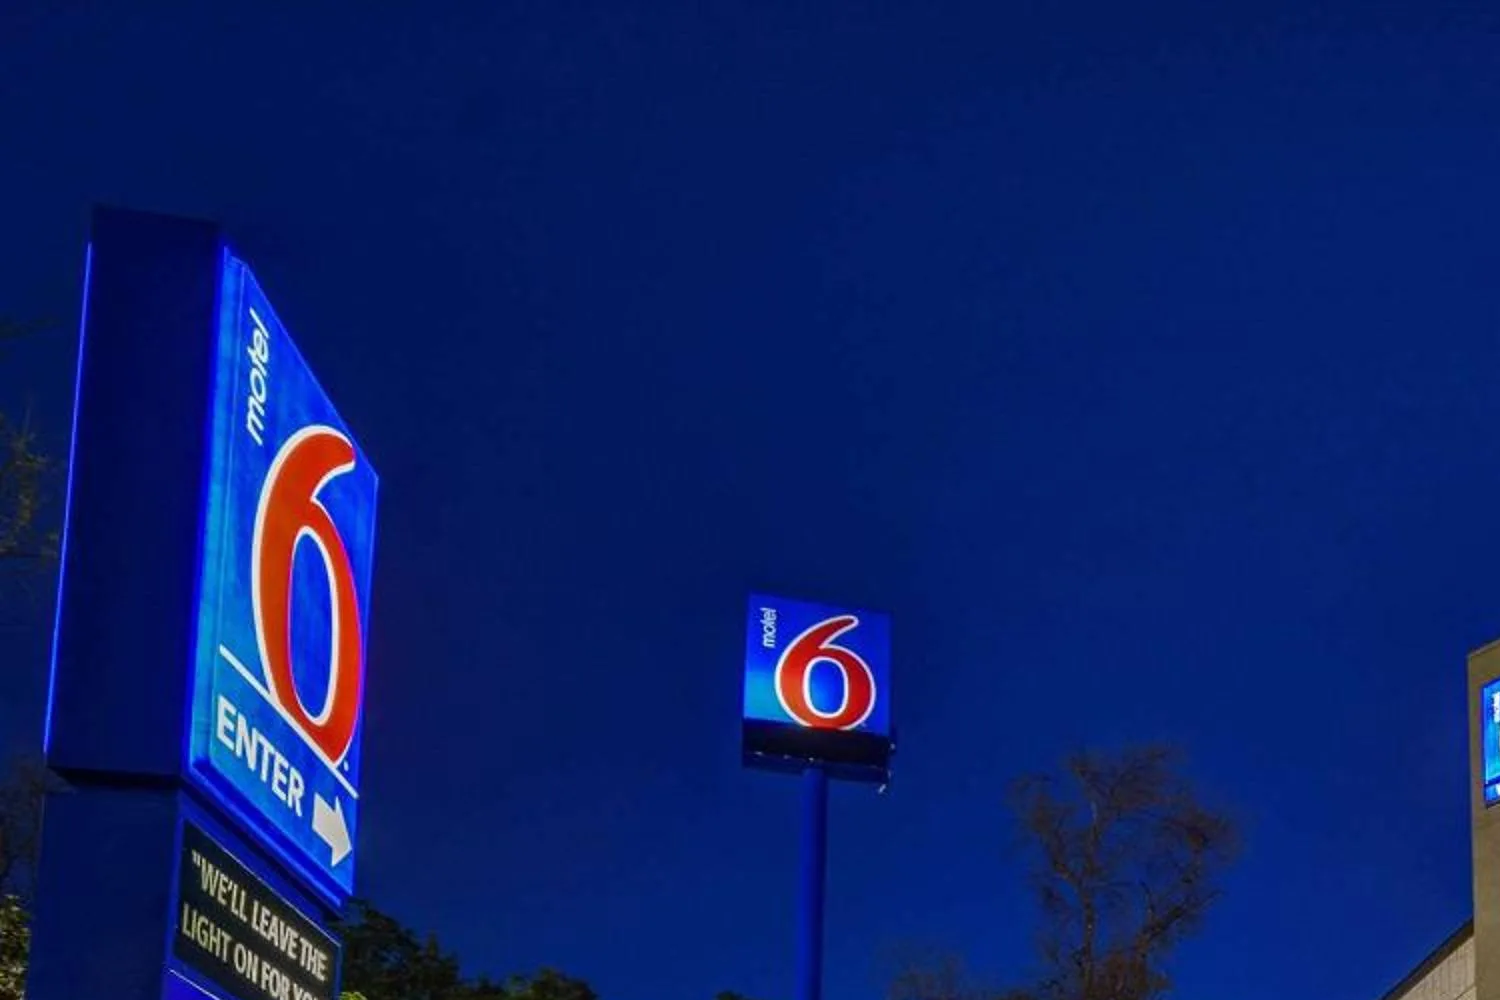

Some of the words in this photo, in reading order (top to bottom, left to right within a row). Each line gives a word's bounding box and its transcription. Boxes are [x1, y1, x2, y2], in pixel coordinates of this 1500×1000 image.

[244, 306, 271, 446] motel
[251, 424, 363, 769] 6
[760, 607, 777, 649] motel
[774, 615, 876, 731] 6
[215, 695, 304, 818] ENTER
[182, 901, 232, 962] LIGHT
[233, 943, 258, 984] ON
[191, 850, 248, 923] "WE'LL
[251, 900, 300, 959] LEAVE
[299, 937, 328, 982] THE
